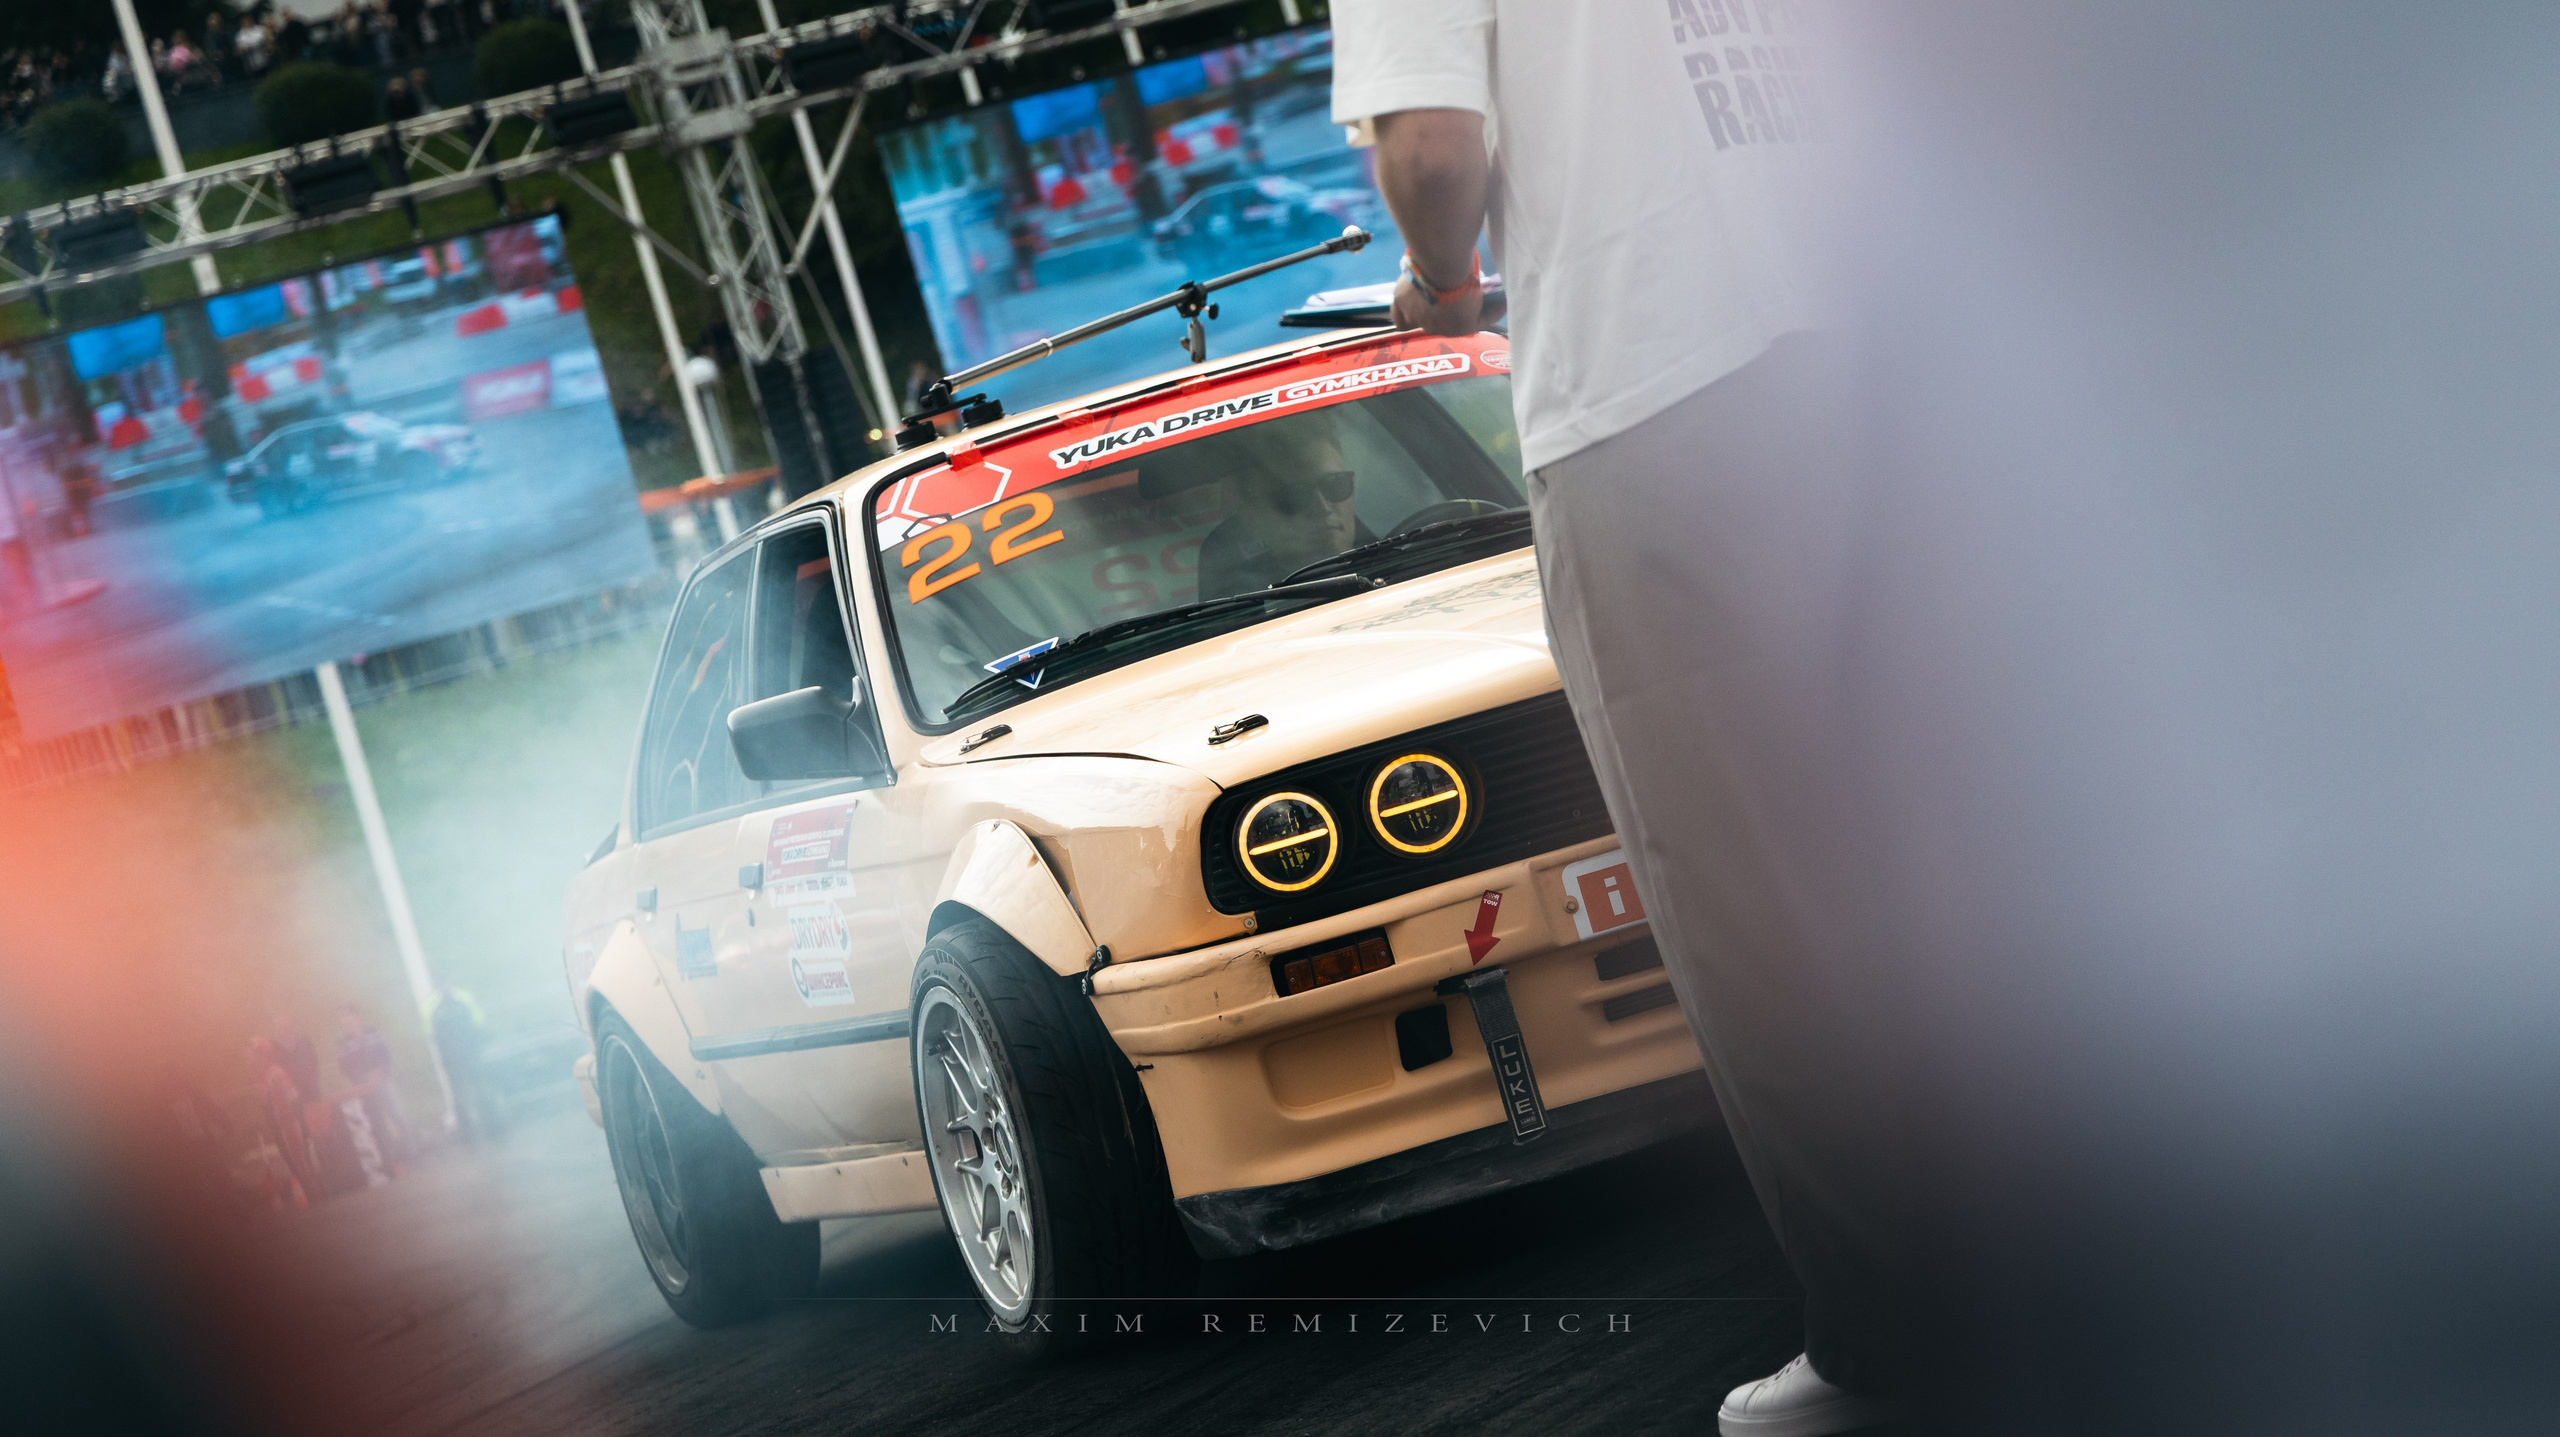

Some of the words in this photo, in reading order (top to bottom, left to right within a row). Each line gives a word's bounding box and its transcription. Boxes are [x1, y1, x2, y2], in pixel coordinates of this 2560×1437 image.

[1057, 426, 1155, 465] YUKA
[1162, 393, 1273, 434] DRIVE
[1285, 358, 1455, 400] GYMKHANA
[900, 491, 1065, 605] 22
[790, 915, 836, 950] DRYDRY
[1499, 1045, 1534, 1116] LUKE
